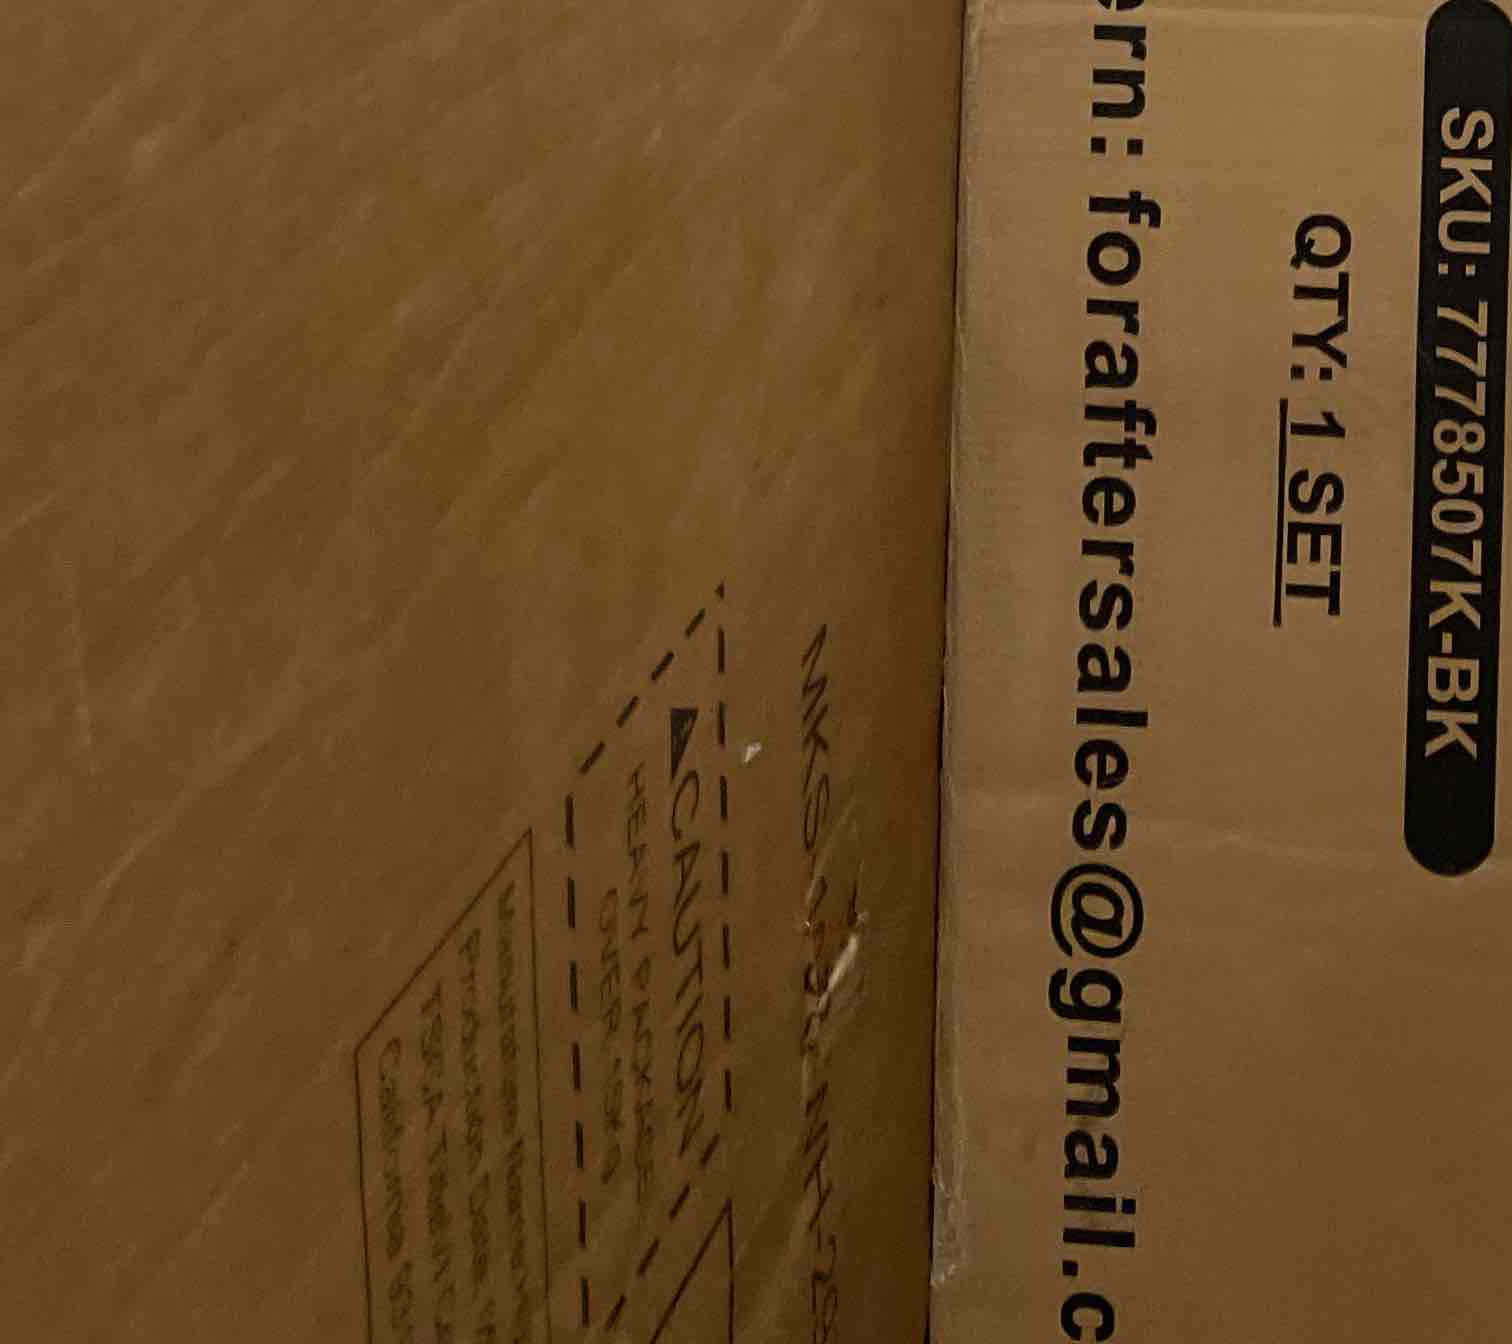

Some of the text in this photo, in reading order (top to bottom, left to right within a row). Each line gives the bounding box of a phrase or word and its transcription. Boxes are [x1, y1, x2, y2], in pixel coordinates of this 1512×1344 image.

[1284, 214, 1352, 617] QTY: 1 SET
[1425, 107, 1494, 759] SKU: 7778507K-BK
[672, 769, 705, 1158] CAUTION
